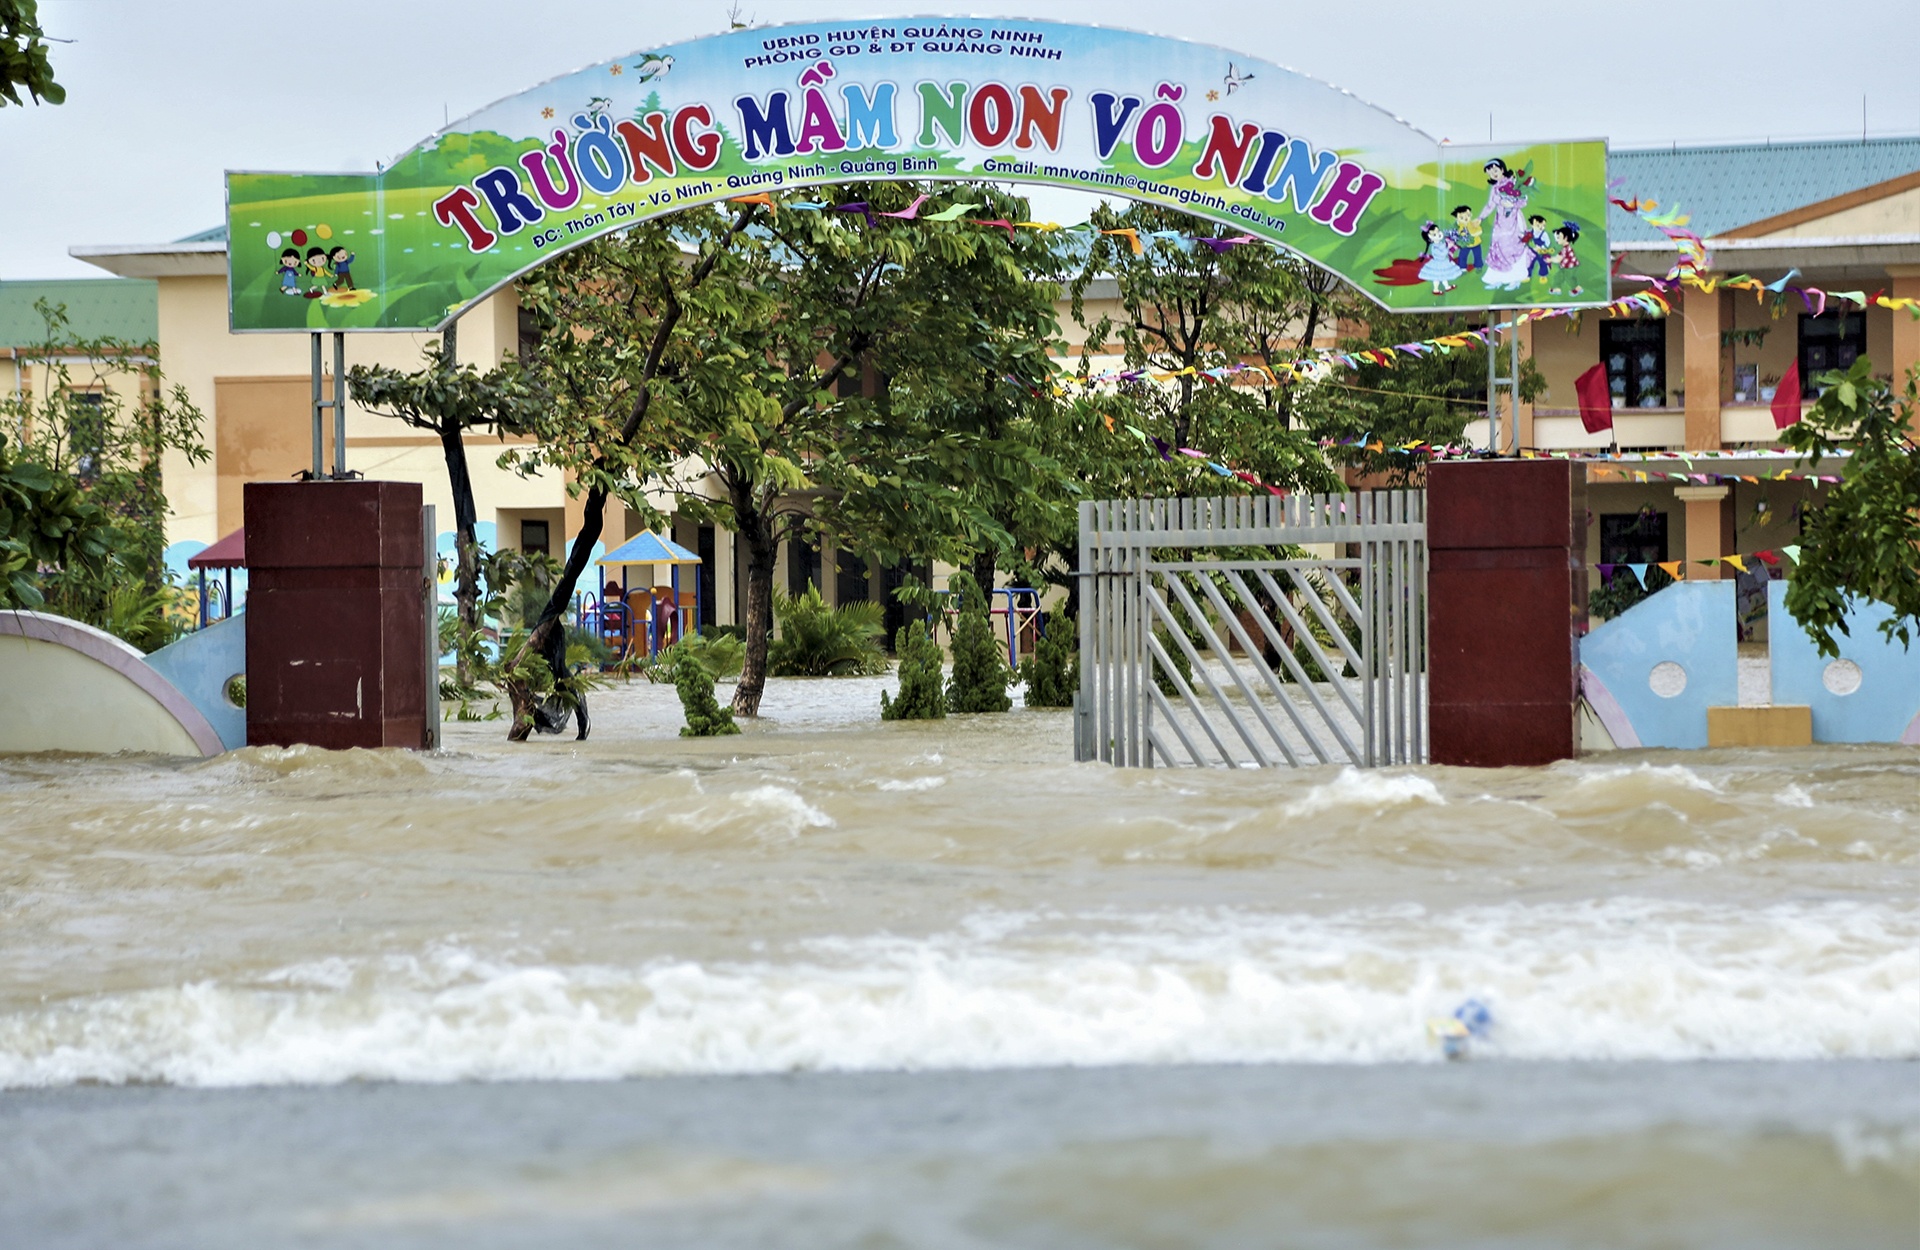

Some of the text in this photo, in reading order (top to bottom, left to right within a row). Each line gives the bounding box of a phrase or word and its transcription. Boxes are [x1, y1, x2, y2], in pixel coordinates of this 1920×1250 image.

[744, 38, 1062, 68] PHÒNG GD & ĐT QUẢNG NINH
[763, 24, 1043, 51] UBND HUYỆN QUẢNG NINH
[435, 61, 1382, 252] TRƯỜNG MẦM NON VÕ NINH
[532, 228, 564, 249] ĐC:
[565, 213, 604, 236] Thôn
[607, 201, 636, 221] Tây
[649, 187, 672, 205] Võ
[675, 181, 713, 201] Ninh
[726, 169, 784, 190] Quảng
[788, 163, 825, 179] Ninh
[840, 156, 897, 175] Quảng
[902, 156, 938, 171] Bình
[983, 158, 1286, 232] Gmail: mnvoninh@quangbinh.edu.vn
